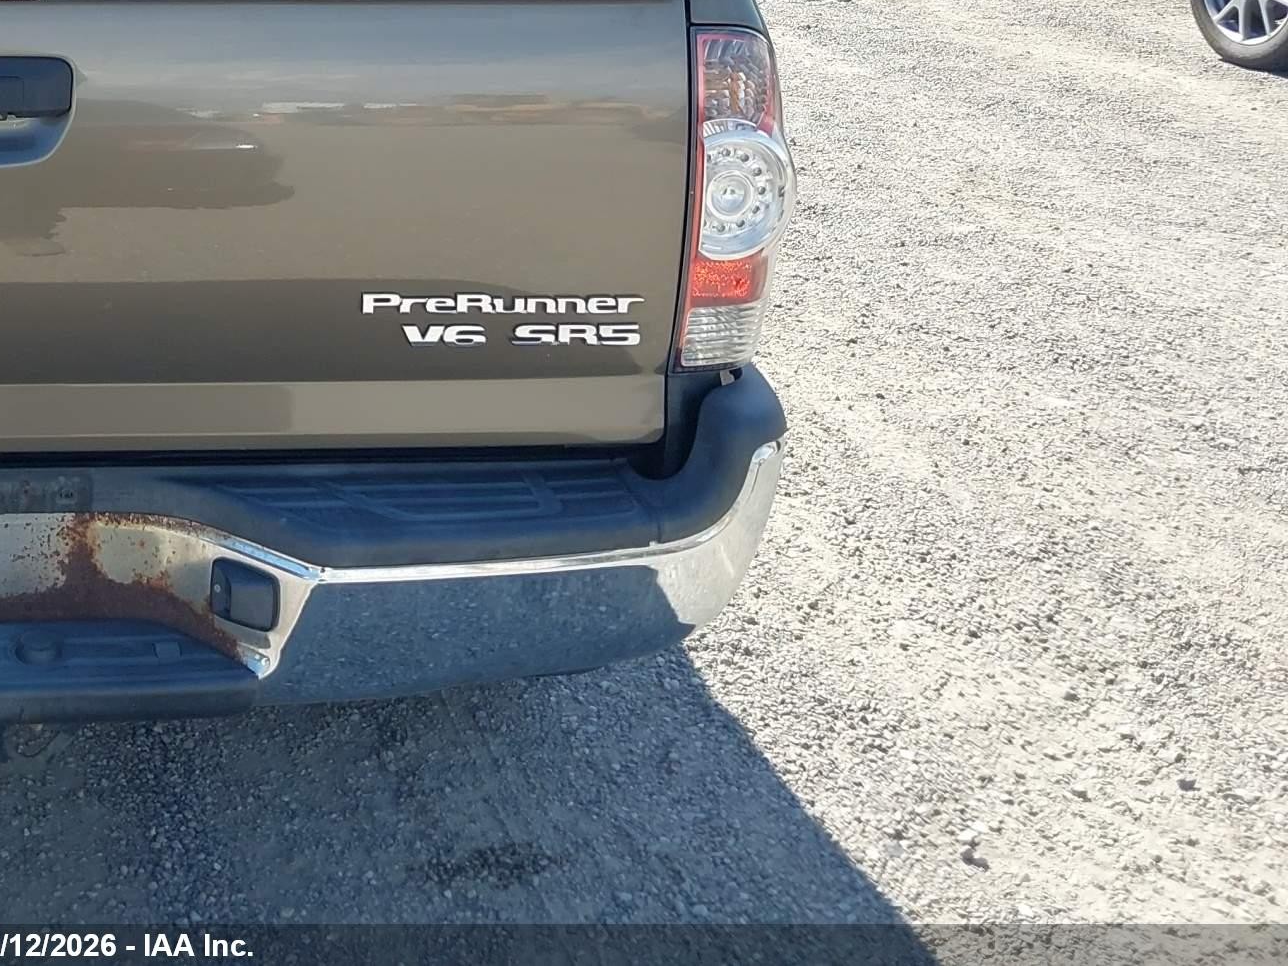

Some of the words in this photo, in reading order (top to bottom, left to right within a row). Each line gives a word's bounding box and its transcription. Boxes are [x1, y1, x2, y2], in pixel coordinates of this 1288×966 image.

[362, 293, 645, 315] PreRunner
[402, 324, 487, 346] V6
[512, 324, 641, 346] SR5
